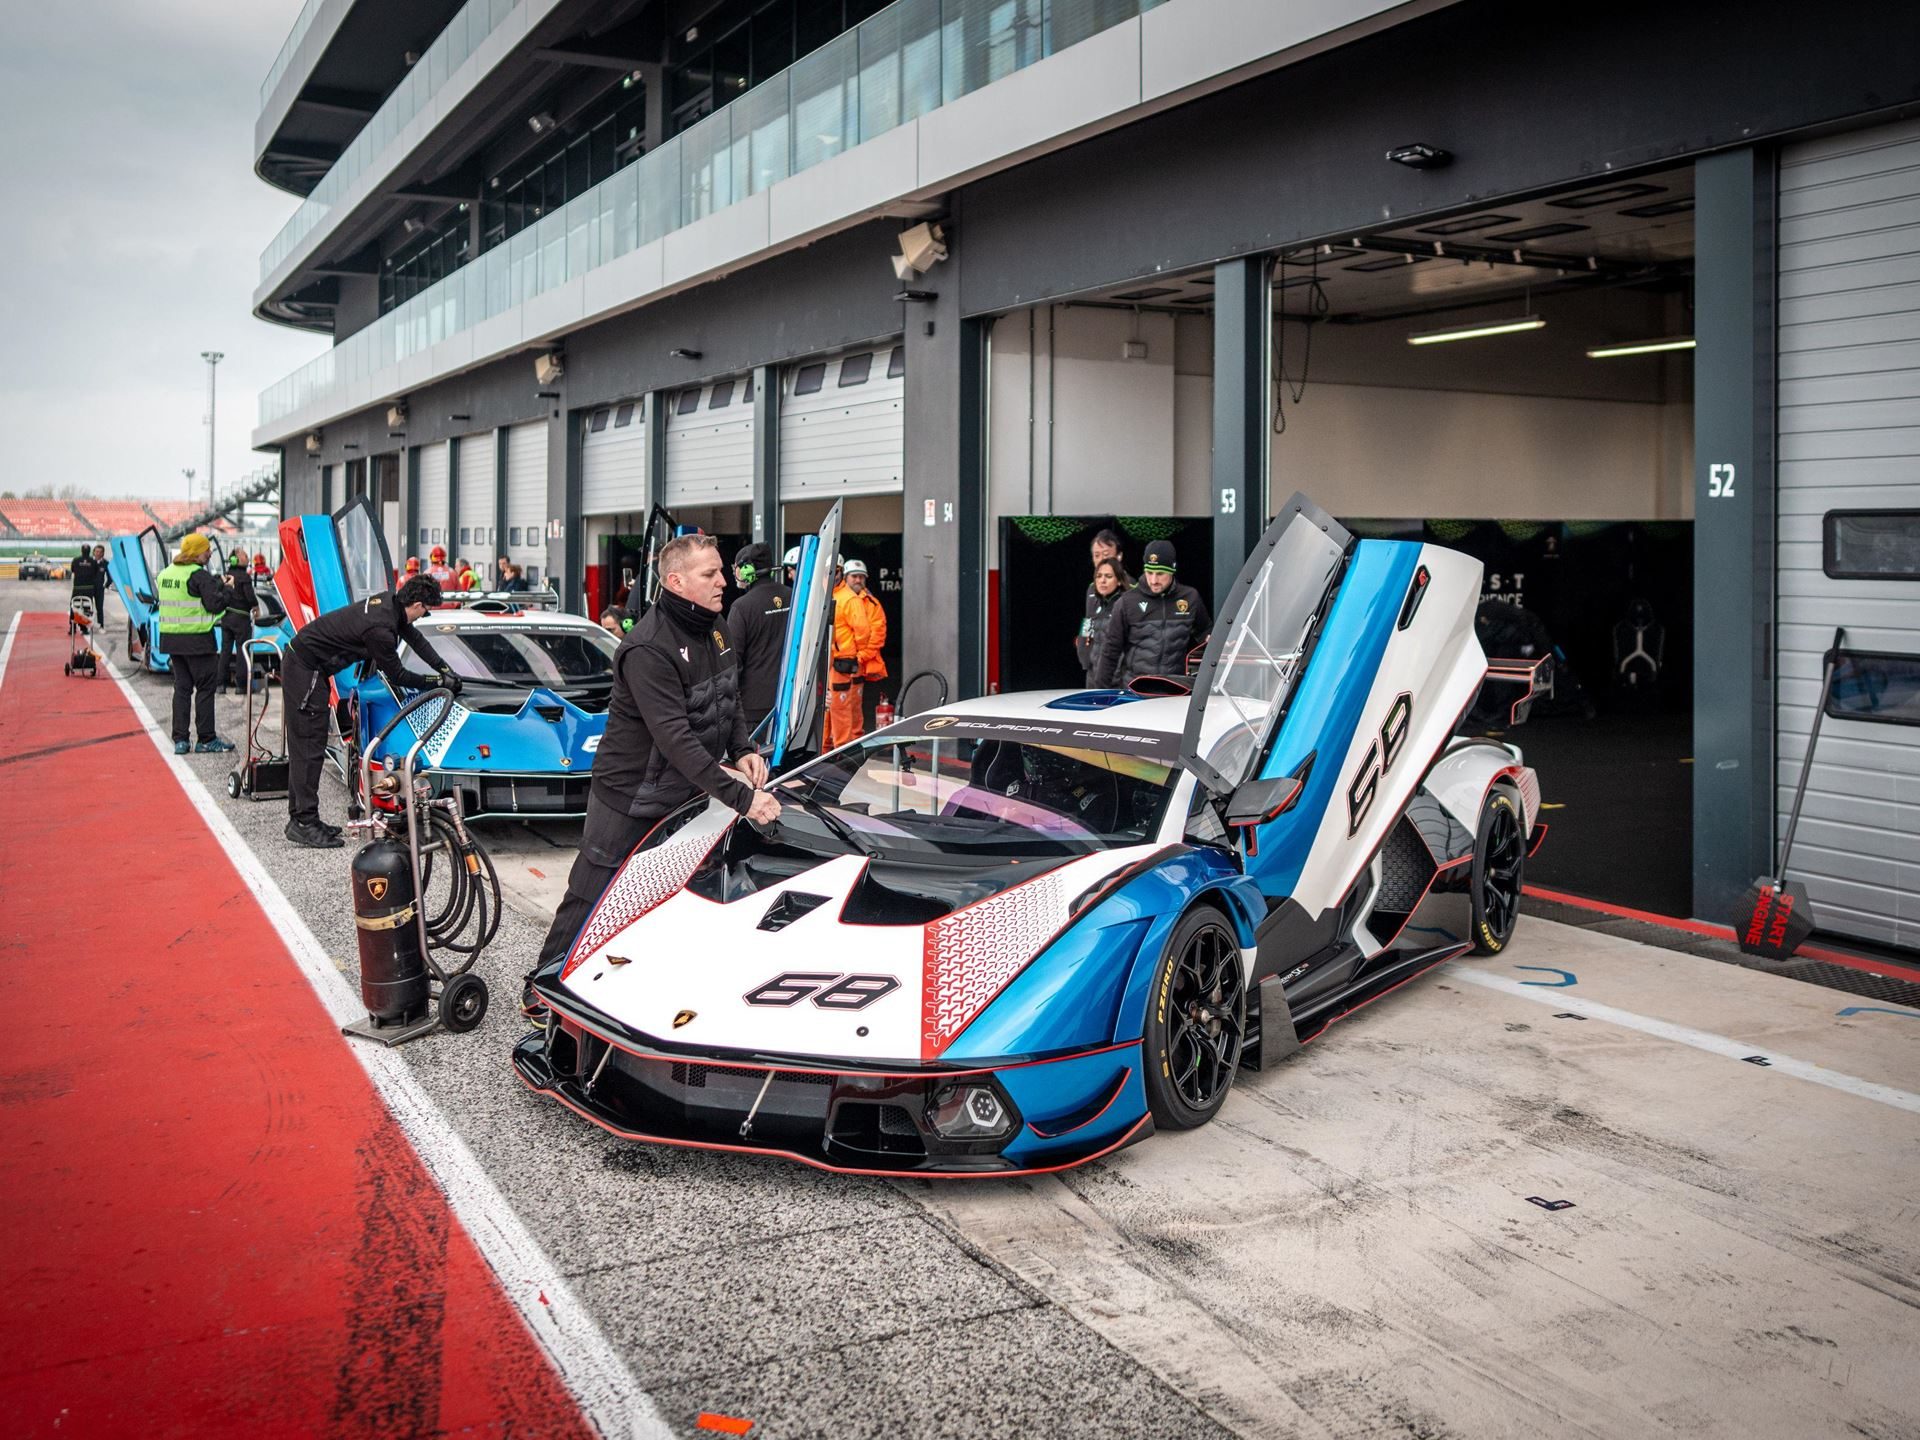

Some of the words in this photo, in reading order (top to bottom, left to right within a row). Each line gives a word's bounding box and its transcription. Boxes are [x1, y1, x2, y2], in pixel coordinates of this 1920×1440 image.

[1709, 463, 1735, 497] 52
[943, 502, 953, 522] 54
[1222, 487, 1236, 513] 53
[954, 721, 1063, 735] SQUADRA
[1073, 730, 1161, 745] CORSE
[1347, 691, 1413, 840] 68
[1745, 885, 1775, 946] ENGINE
[1767, 894, 1795, 948] START
[742, 971, 902, 1012] 68
